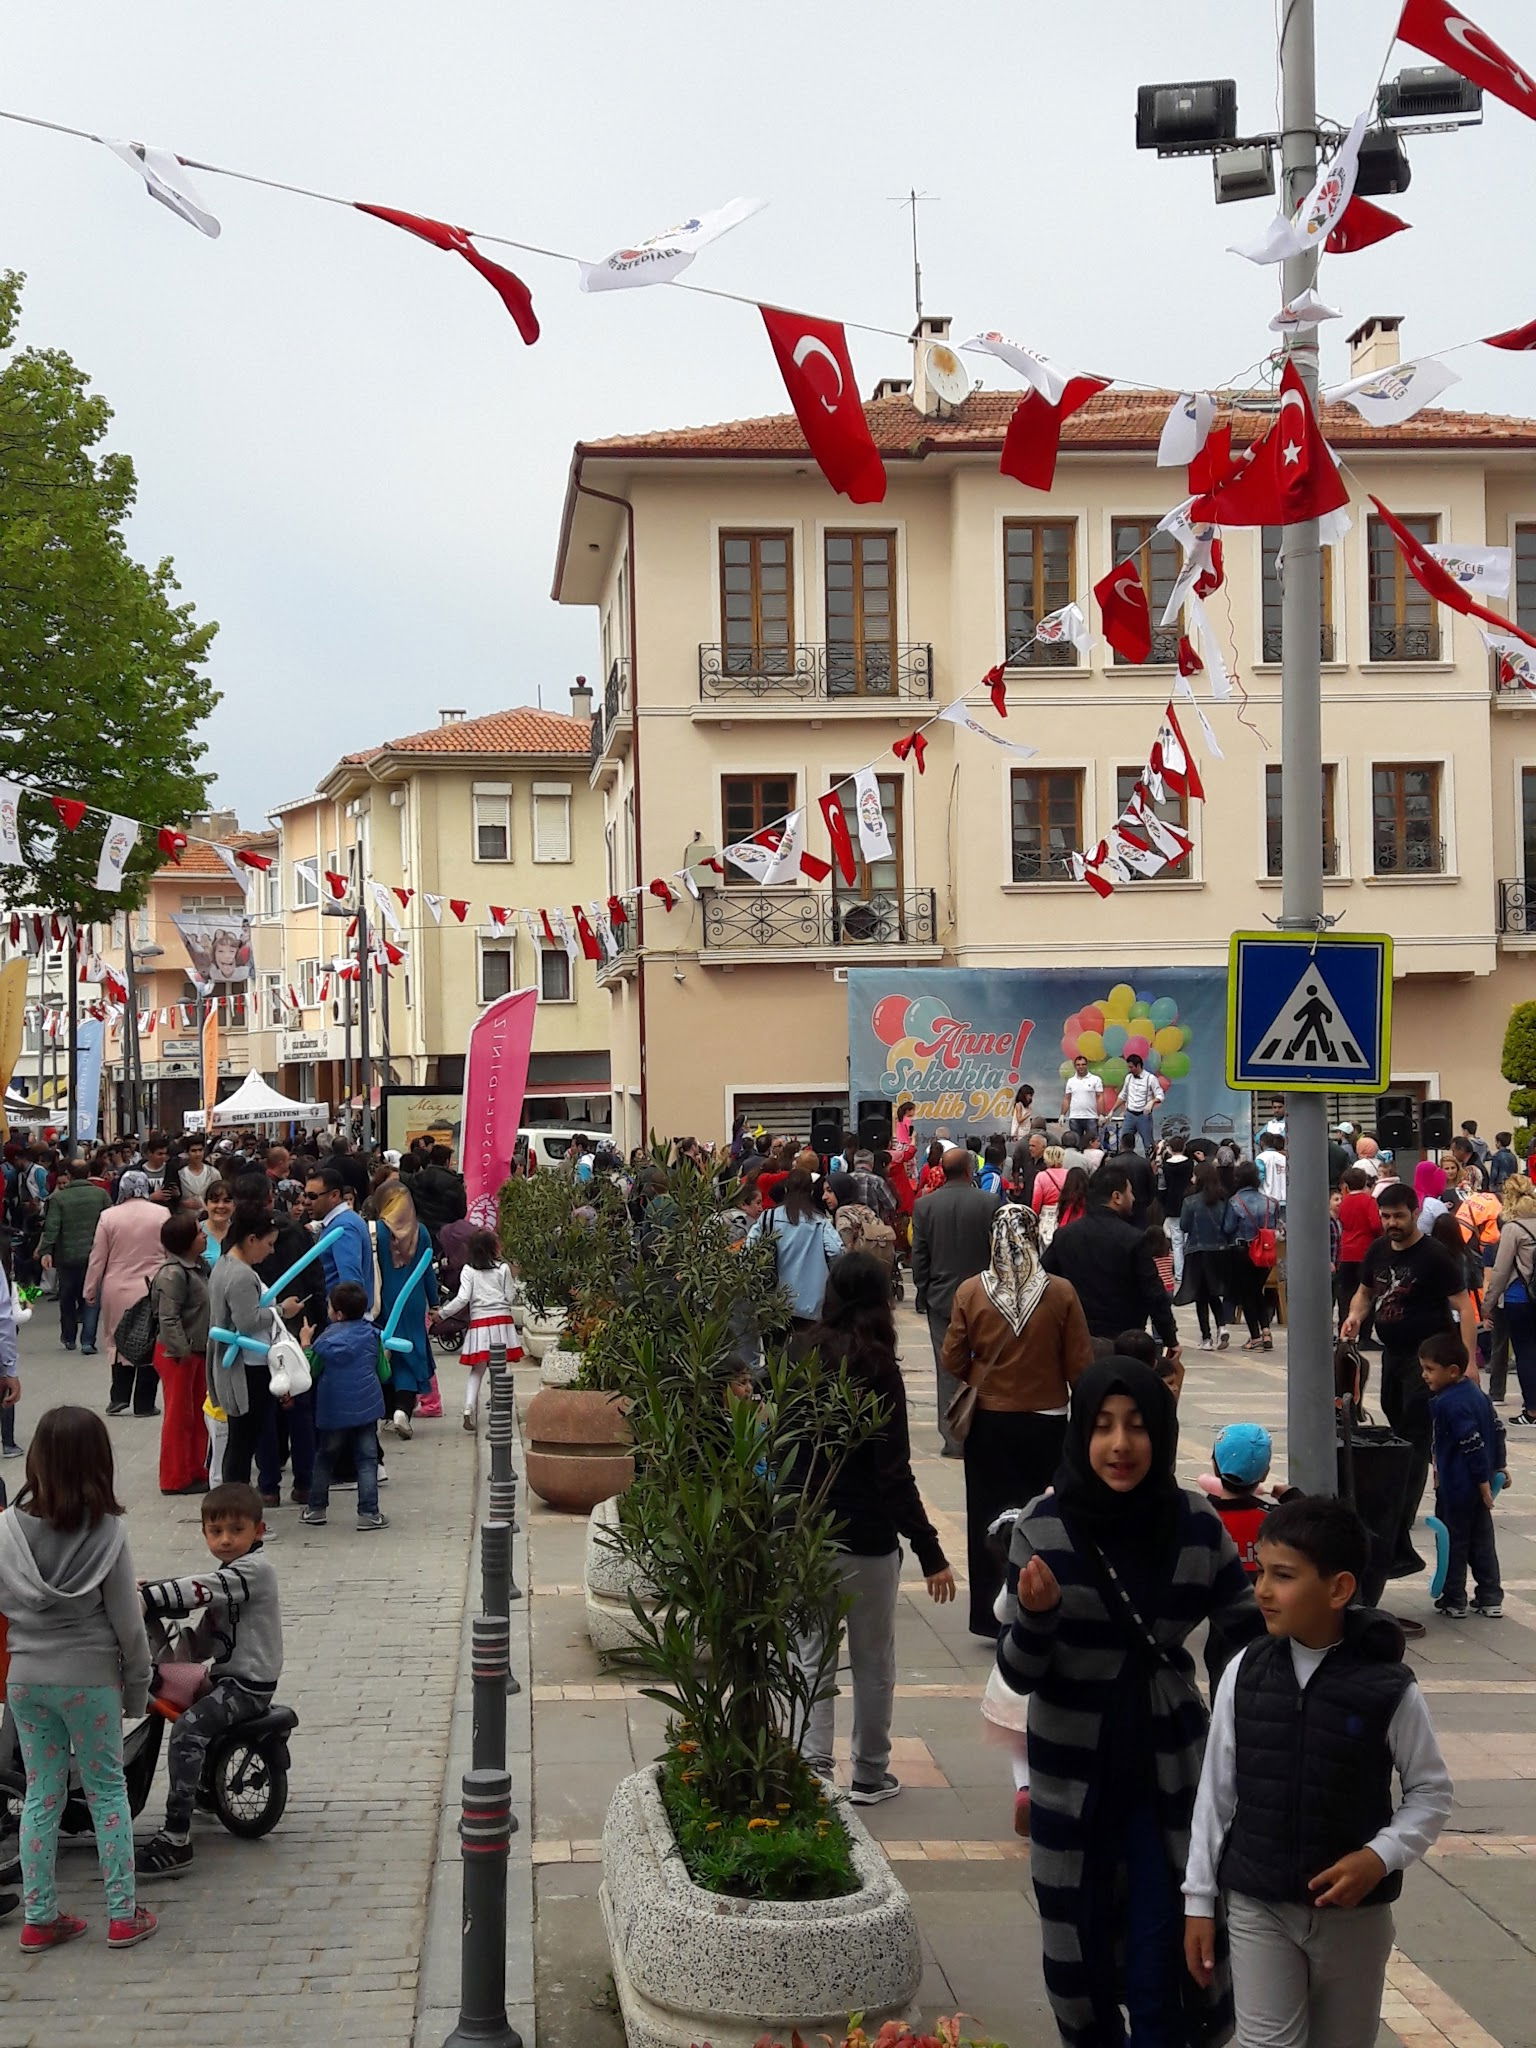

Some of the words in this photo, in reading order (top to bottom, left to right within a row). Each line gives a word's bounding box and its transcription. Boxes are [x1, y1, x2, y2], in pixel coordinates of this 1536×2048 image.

[914, 1016, 1036, 1085] Anne!
[880, 1057, 1005, 1096] Sokakta
[968, 1086, 1016, 1122] Va
